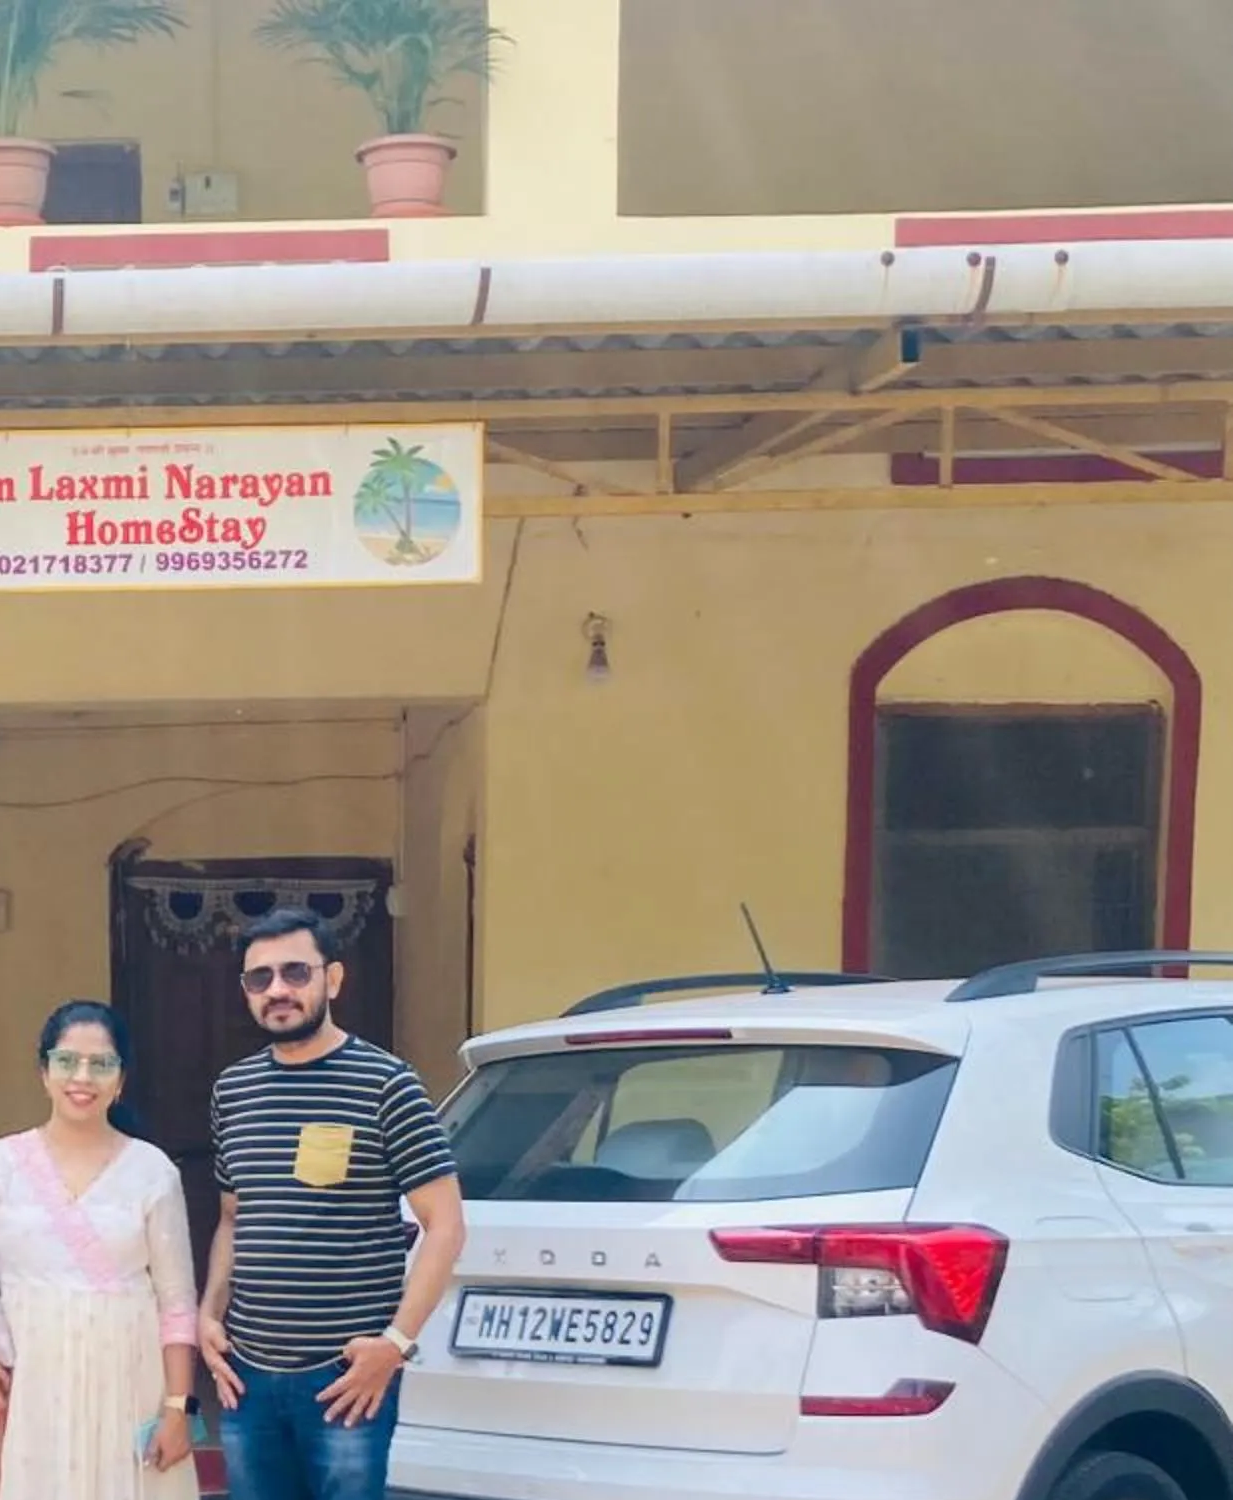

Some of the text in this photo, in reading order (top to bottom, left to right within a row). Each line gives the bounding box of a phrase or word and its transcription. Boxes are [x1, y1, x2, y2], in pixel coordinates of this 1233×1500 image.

[29, 464, 149, 501] Laxmi
[165, 463, 332, 506] Narayan
[66, 507, 266, 549] HomeStay
[156, 549, 308, 571] 9969356272
[479, 1303, 655, 1345] MH12WE5829
